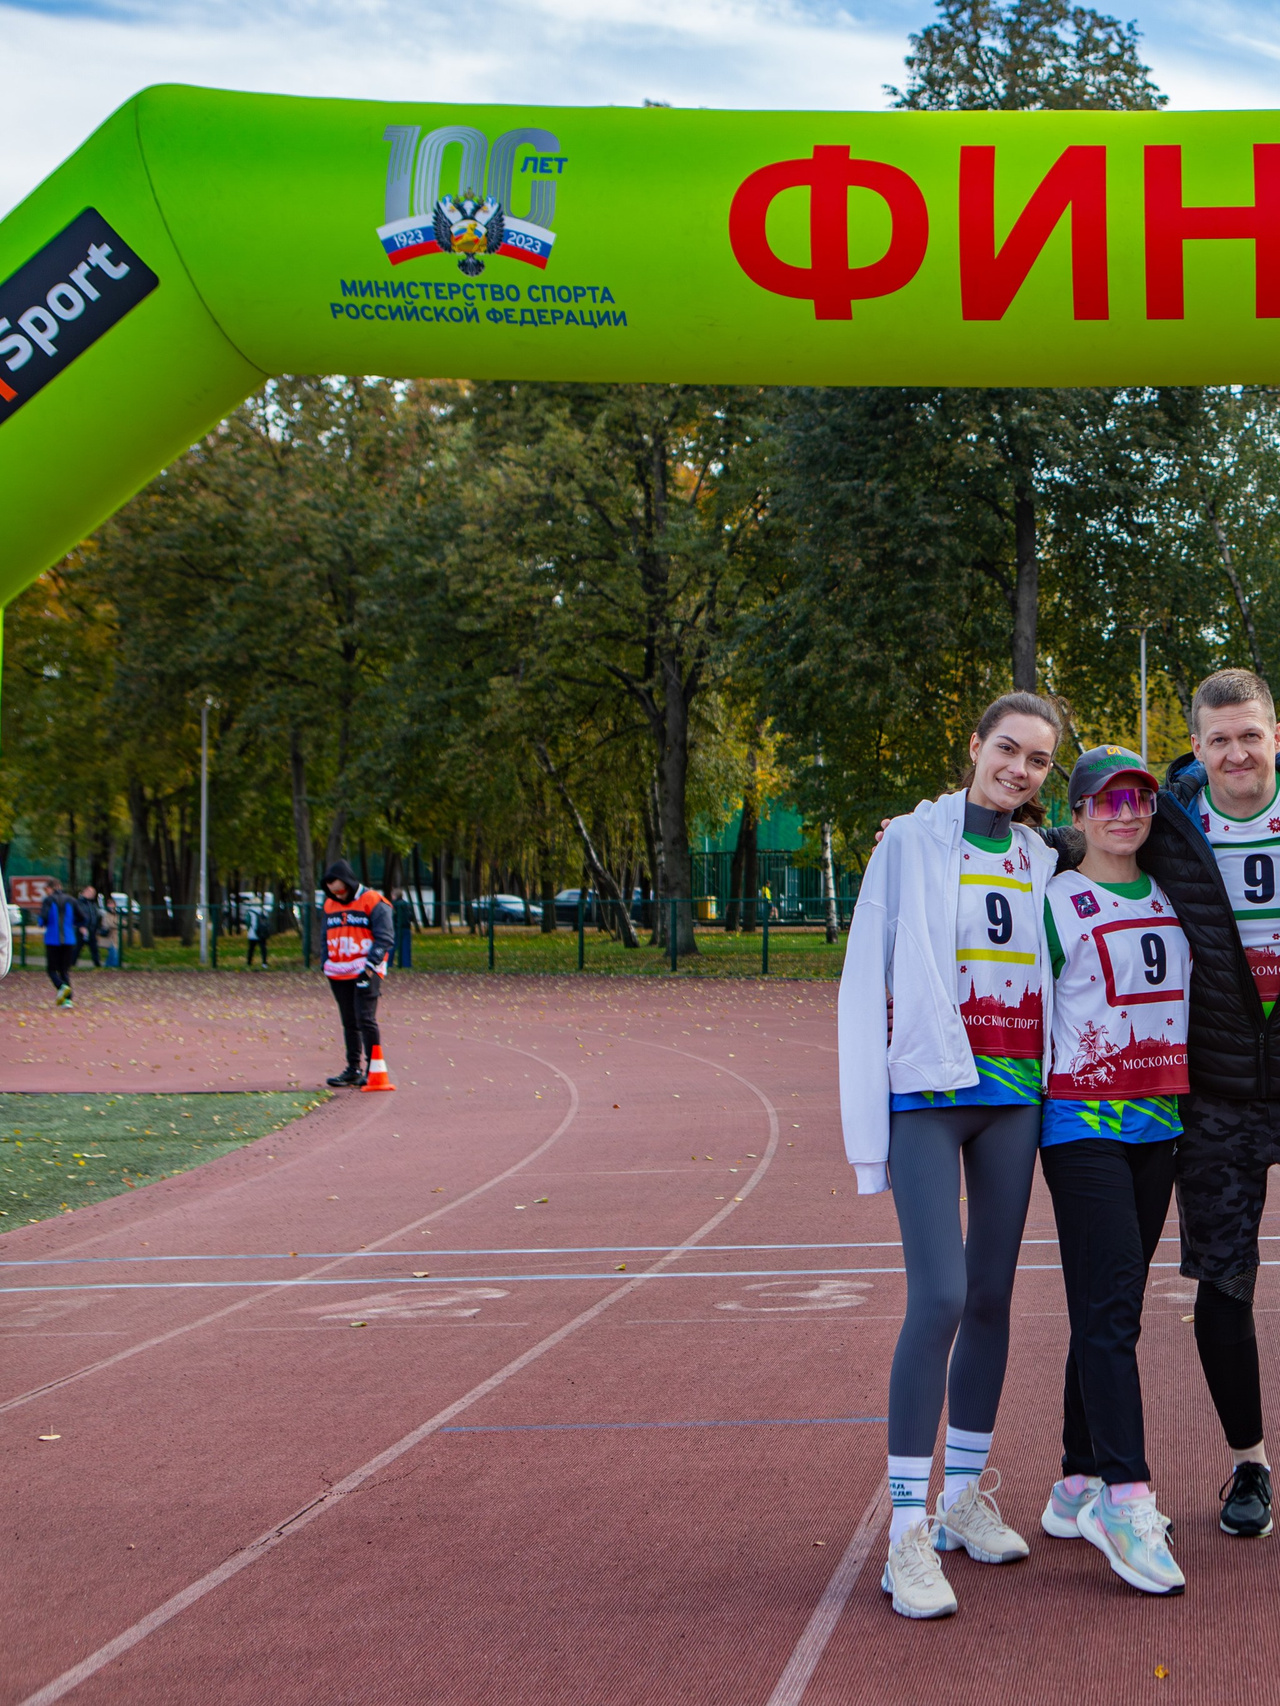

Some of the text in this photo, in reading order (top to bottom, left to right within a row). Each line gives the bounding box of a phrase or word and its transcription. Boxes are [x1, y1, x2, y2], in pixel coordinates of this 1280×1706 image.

[520, 156, 569, 174] ЛЕТ
[393, 229, 424, 249] 1923
[507, 231, 542, 254] 2023
[340, 279, 616, 304] МИНИСТЕРСТВО СПОРТА
[0, 242, 130, 372] Sport
[330, 302, 628, 328] РОССИЙСКОЙ ФЕДЕРАЦИИ
[1243, 853, 1276, 904] 9
[985, 892, 1014, 945] 9
[1140, 932, 1167, 985] 9
[1122, 1053, 1189, 1071] МОСКОМСП
